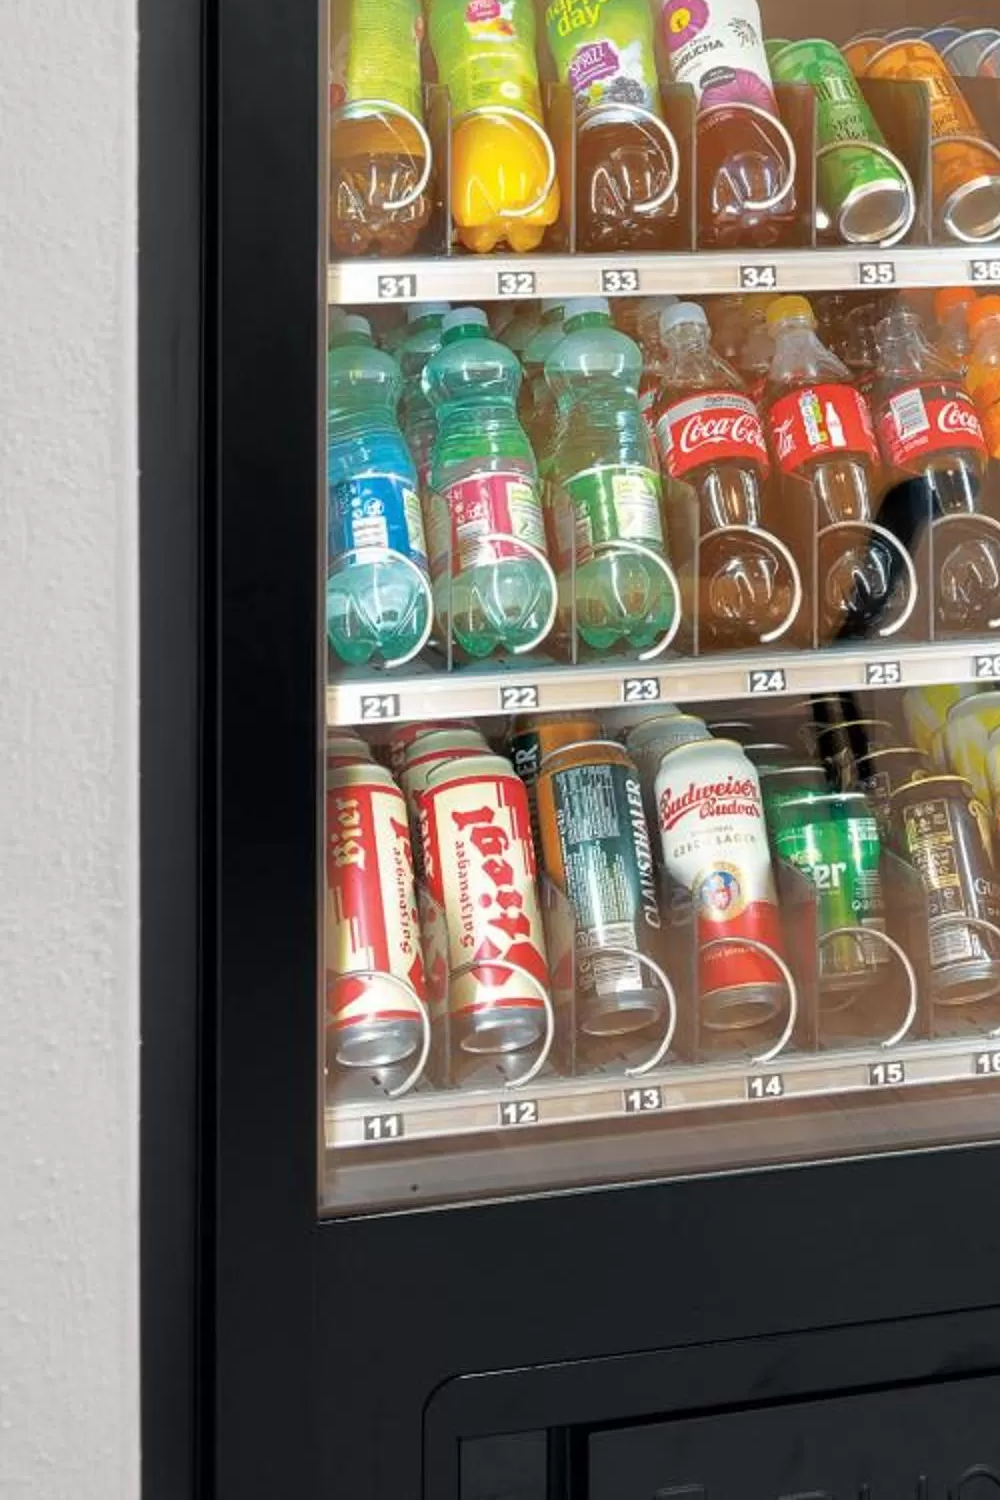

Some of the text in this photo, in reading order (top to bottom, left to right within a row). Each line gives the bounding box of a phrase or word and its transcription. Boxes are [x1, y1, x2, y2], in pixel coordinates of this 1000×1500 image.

[556, 2, 601, 37] day
[501, 273, 534, 294] 32
[604, 270, 638, 290] 33
[741, 267, 776, 288] 34
[863, 264, 894, 283] 35
[381, 276, 415, 298] 31
[753, 671, 784, 691] 24
[868, 664, 899, 683] 25
[502, 687, 535, 708] 22
[626, 680, 658, 701] 23
[364, 697, 397, 717] 21
[659, 775, 758, 829] Budweiser
[699, 797, 761, 821] Budvar
[334, 797, 366, 870] Bier
[625, 778, 661, 930] CLAUSTHALER
[450, 805, 550, 988] Stiegl
[455, 839, 475, 949] Salzburger
[872, 1063, 902, 1084] 15
[751, 1076, 782, 1096] 14
[628, 1089, 659, 1110] 13
[503, 1103, 536, 1123] 12
[368, 1118, 400, 1138] 11
